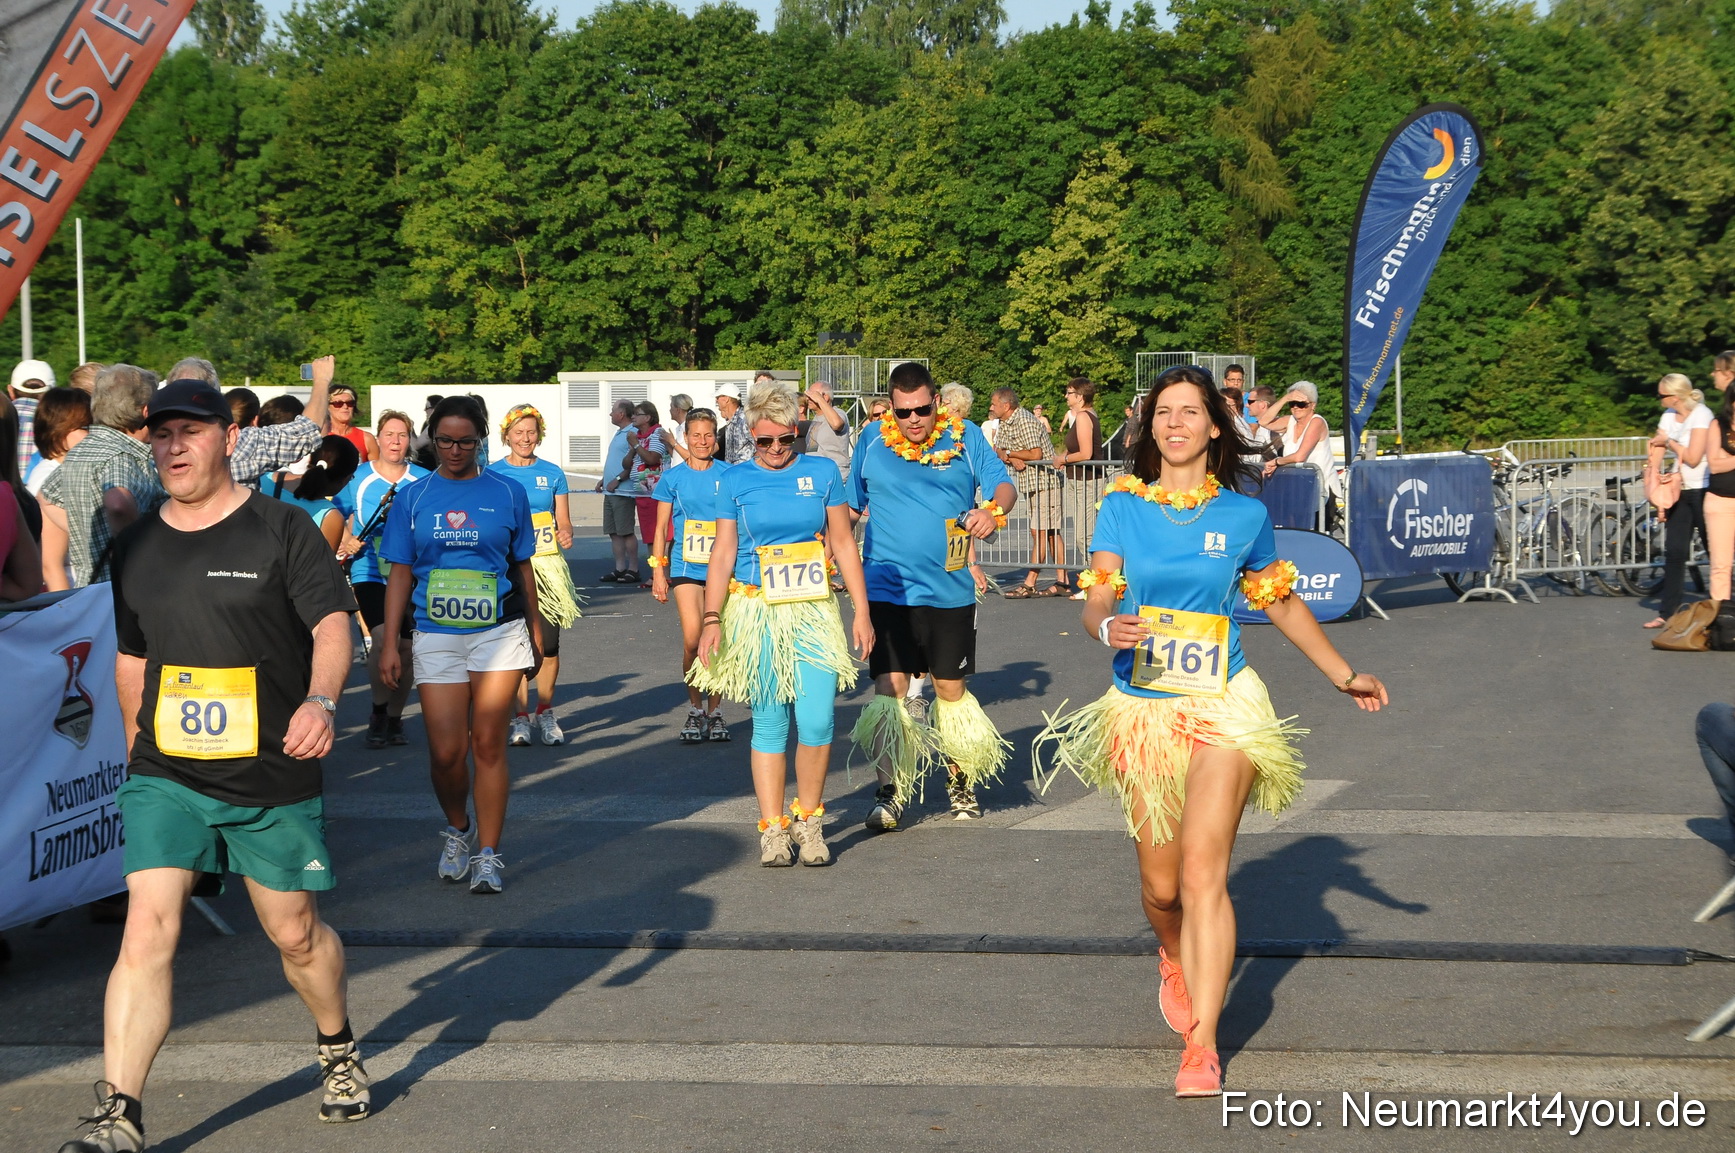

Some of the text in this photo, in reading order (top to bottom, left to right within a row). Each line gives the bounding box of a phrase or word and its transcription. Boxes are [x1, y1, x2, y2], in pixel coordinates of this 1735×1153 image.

[1355, 182, 1442, 329] Frischmann
[1353, 306, 1404, 415] www.frischmann-net.de
[433, 513, 443, 530] I
[433, 528, 479, 541] camping
[1404, 506, 1474, 540] Fischer
[534, 526, 553, 546] 75
[685, 535, 716, 552] 117
[1409, 541, 1468, 558] AUTOMOBILE
[232, 571, 258, 579] Simbeck
[763, 561, 824, 589] 1176
[431, 597, 492, 621] 5050
[1140, 636, 1220, 676] 1161
[180, 700, 227, 736] 80
[45, 760, 125, 818] Neumarkter
